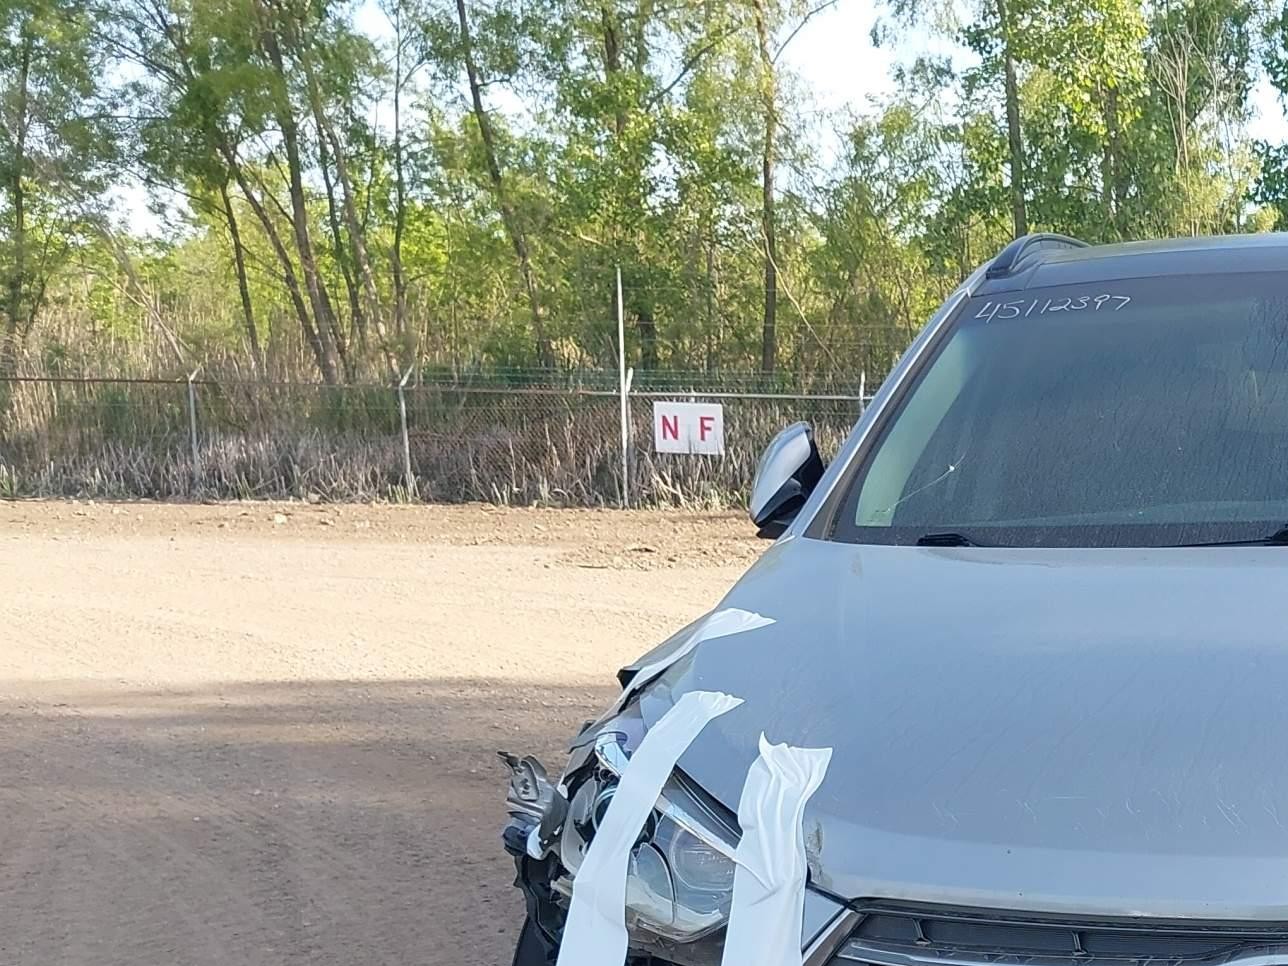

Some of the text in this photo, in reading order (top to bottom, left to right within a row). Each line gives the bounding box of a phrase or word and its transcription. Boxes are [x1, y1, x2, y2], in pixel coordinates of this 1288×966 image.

[975, 294, 1131, 324] 45112397
[661, 415, 715, 442] N F
